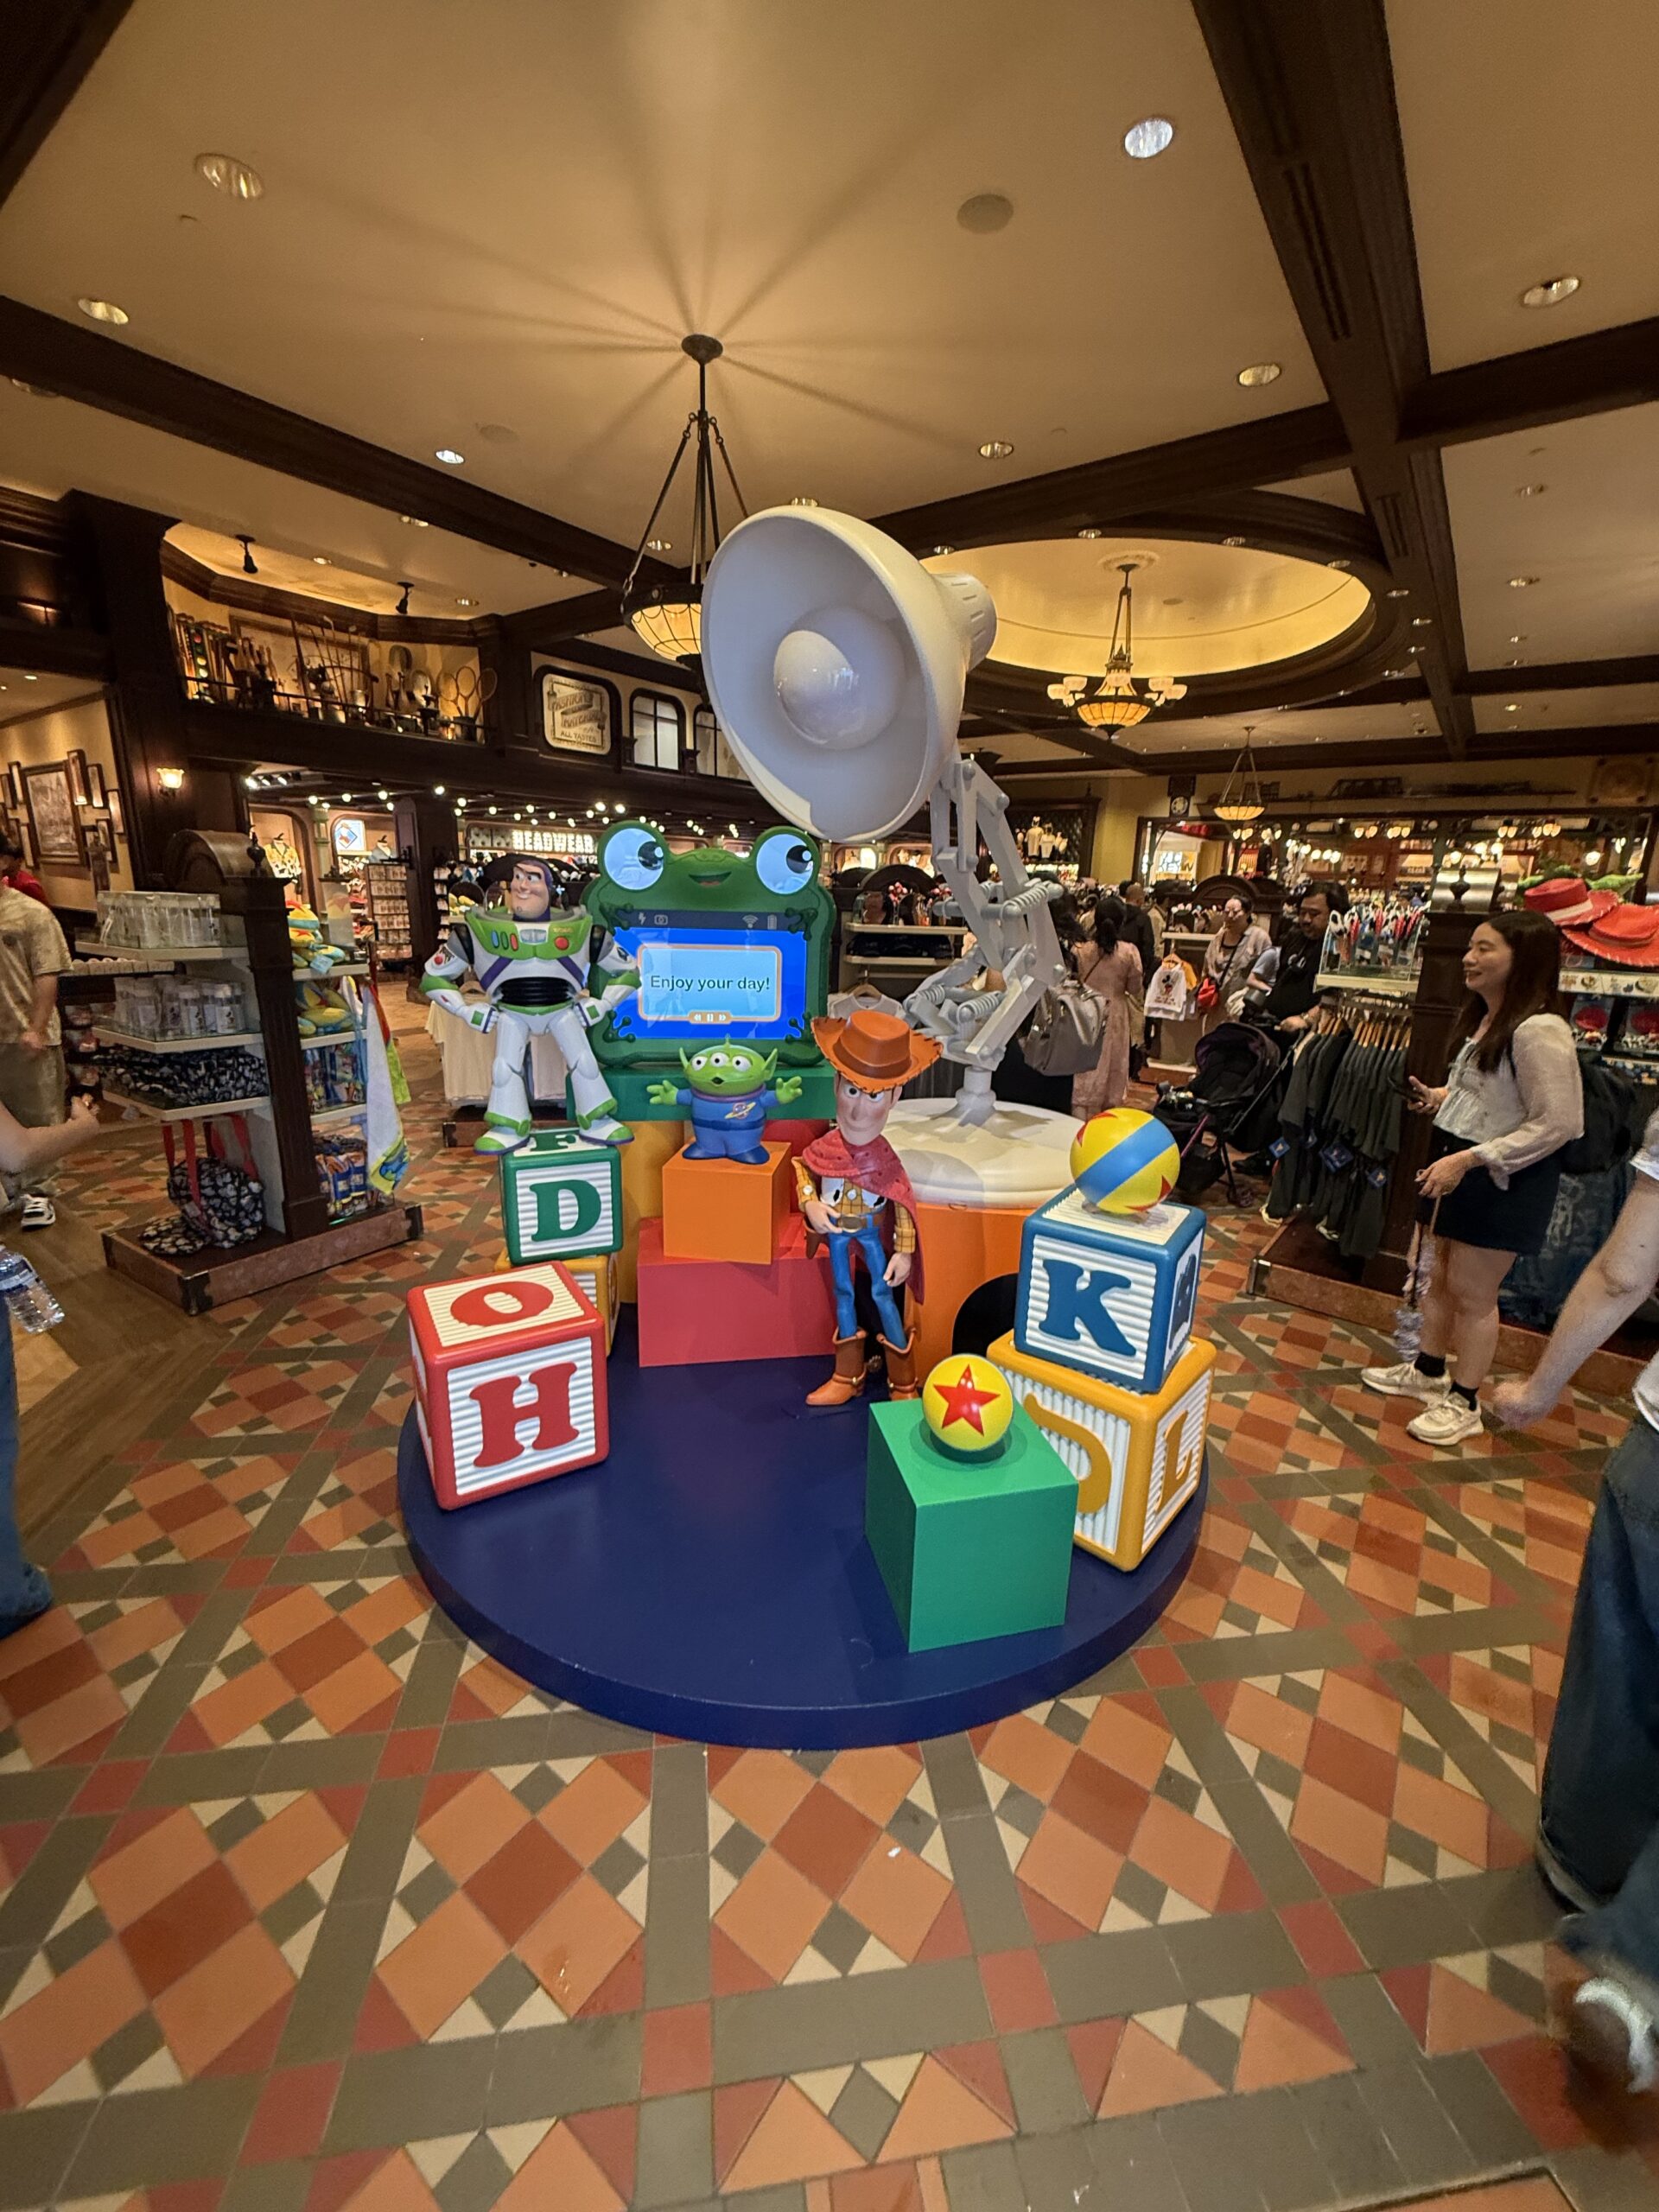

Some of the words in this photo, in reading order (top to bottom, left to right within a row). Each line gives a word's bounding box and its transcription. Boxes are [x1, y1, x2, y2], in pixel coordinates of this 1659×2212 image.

[512, 830, 594, 854] HEADWEAR
[651, 975, 693, 992] Enjoy
[697, 977, 733, 992] your
[737, 976, 770, 993] day!
[529, 1179, 602, 1243] D
[449, 1281, 554, 1327] O
[1038, 1258, 1137, 1357] K
[468, 1361, 580, 1468] H
[1156, 1409, 1193, 1513] L
